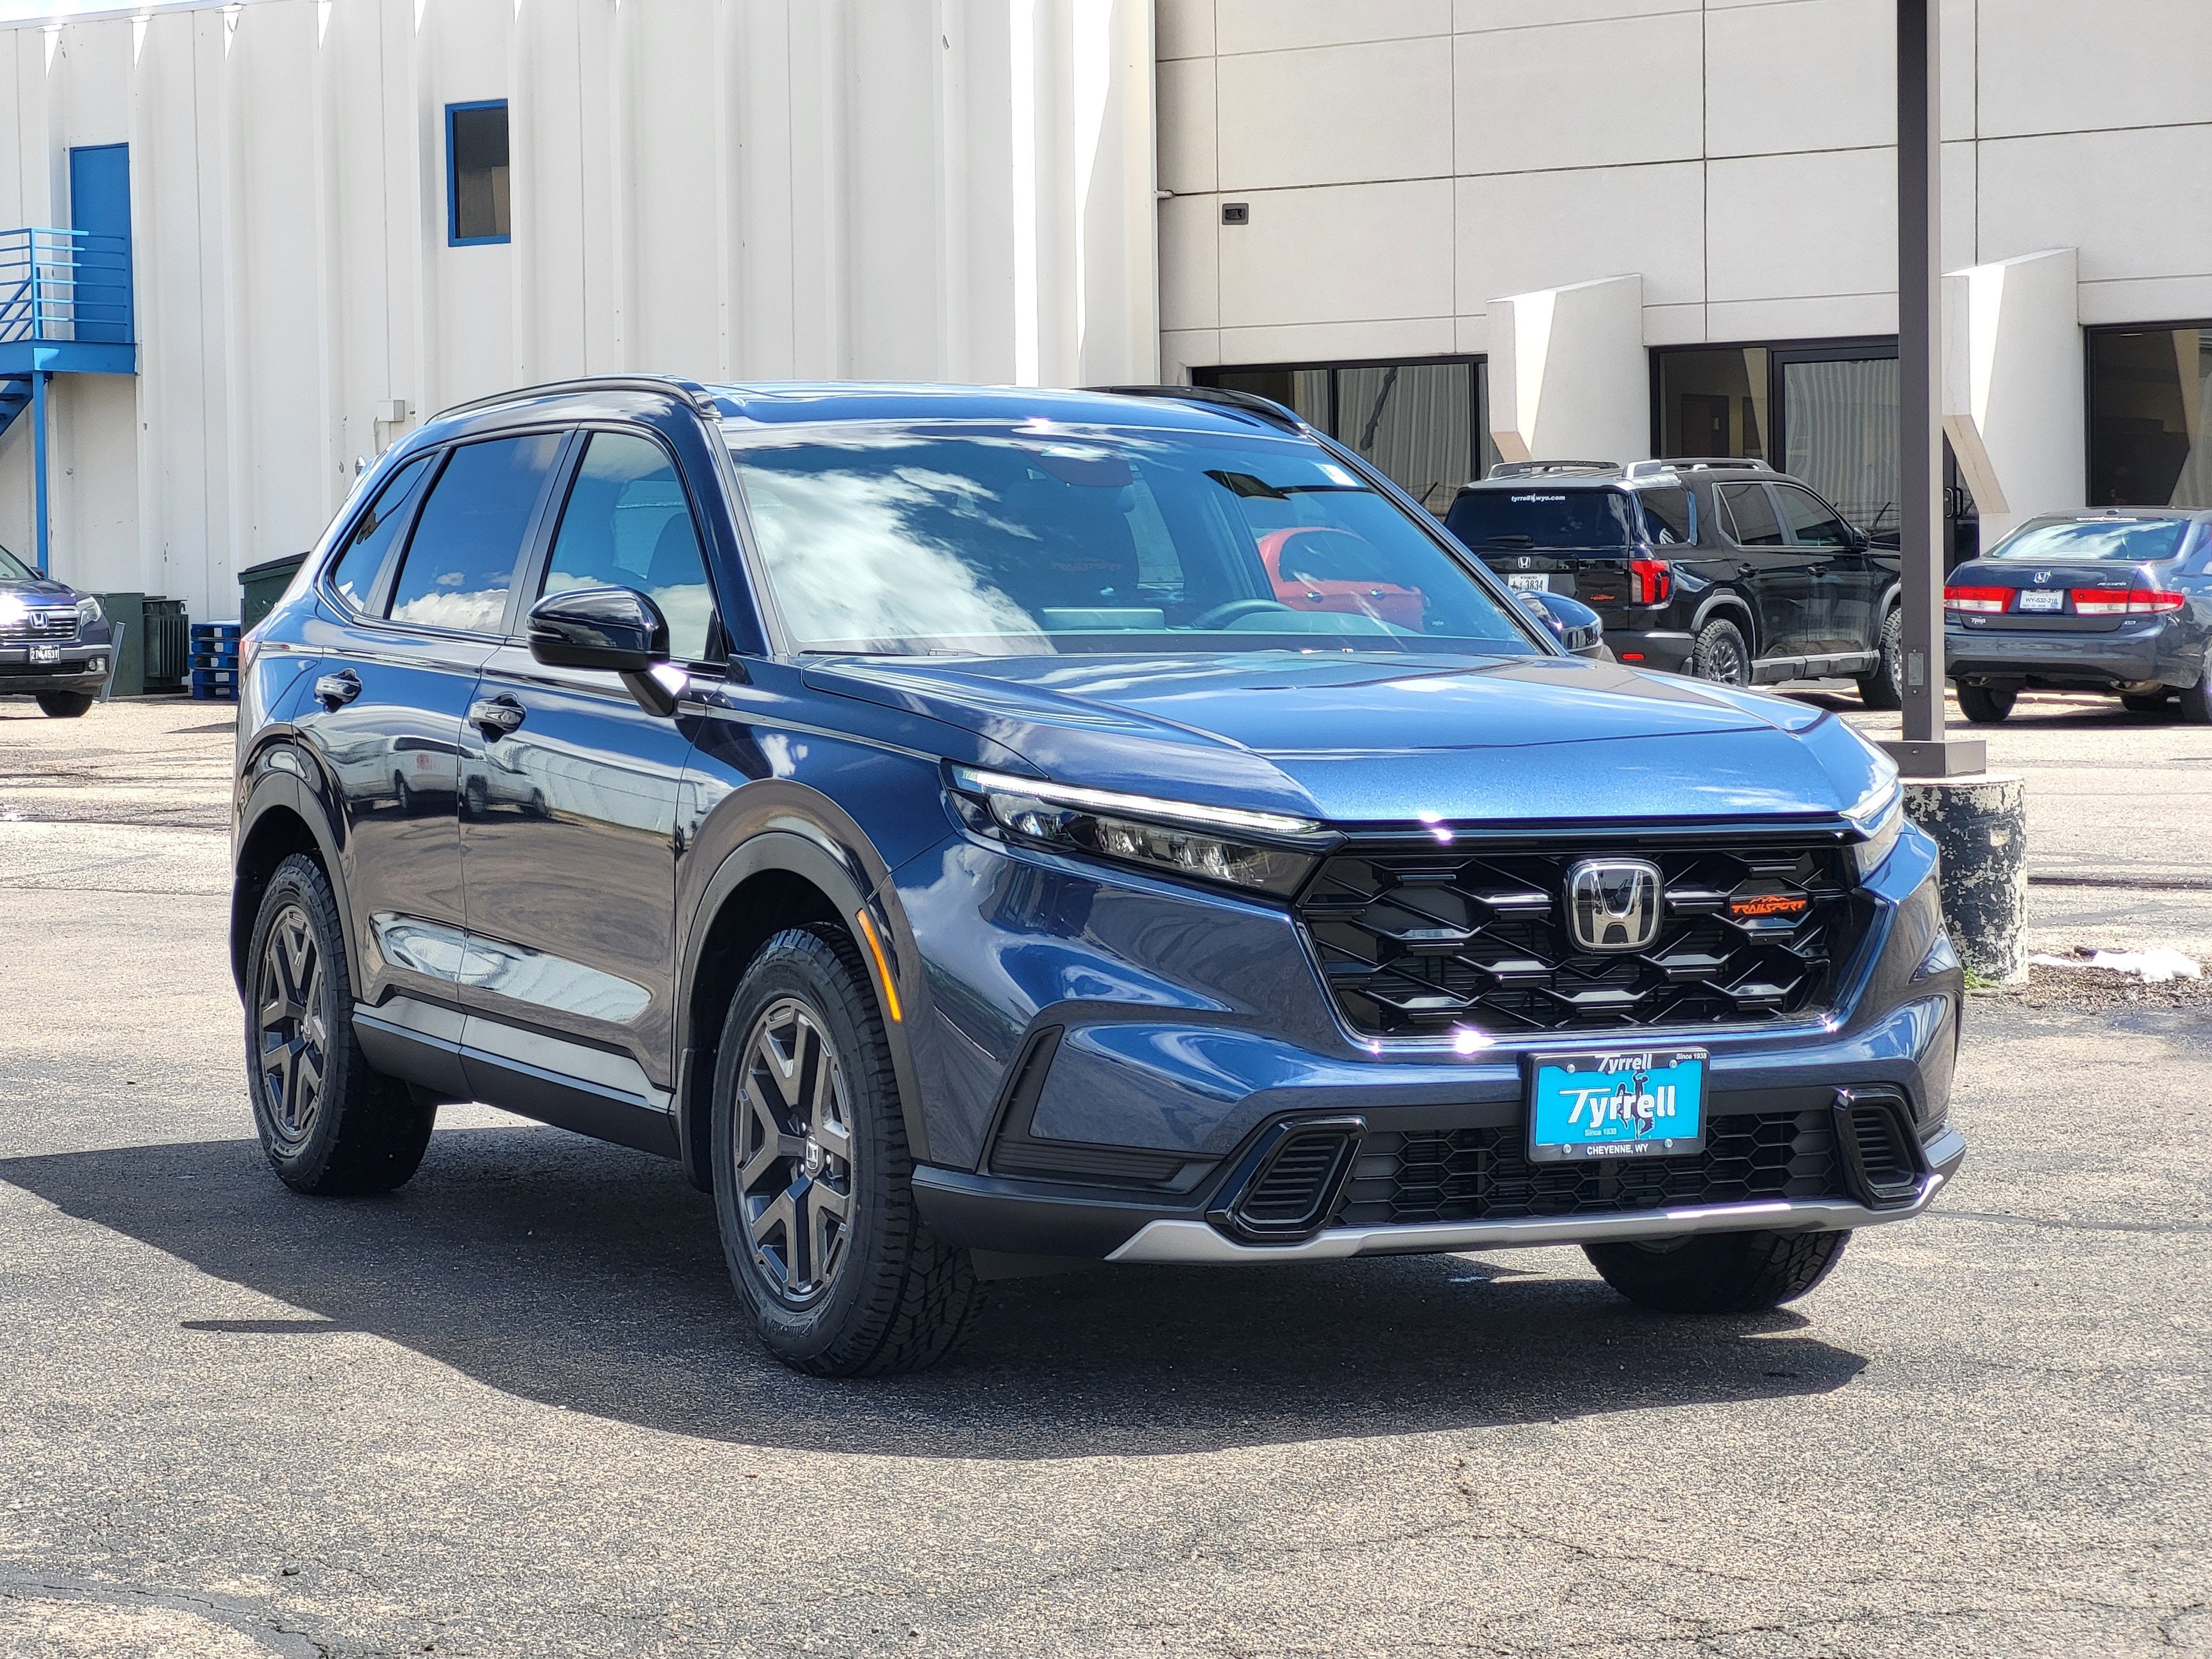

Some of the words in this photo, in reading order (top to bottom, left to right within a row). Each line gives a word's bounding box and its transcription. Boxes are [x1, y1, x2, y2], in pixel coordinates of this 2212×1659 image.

[1731, 899, 1806, 915] TRAILSPORT
[1595, 1053, 1652, 1074] Tyrrell
[1559, 1084, 1676, 1128] Tyrrell
[1587, 1144, 1634, 1155] CHEYENNE,
[1635, 1143, 1648, 1153] WY
